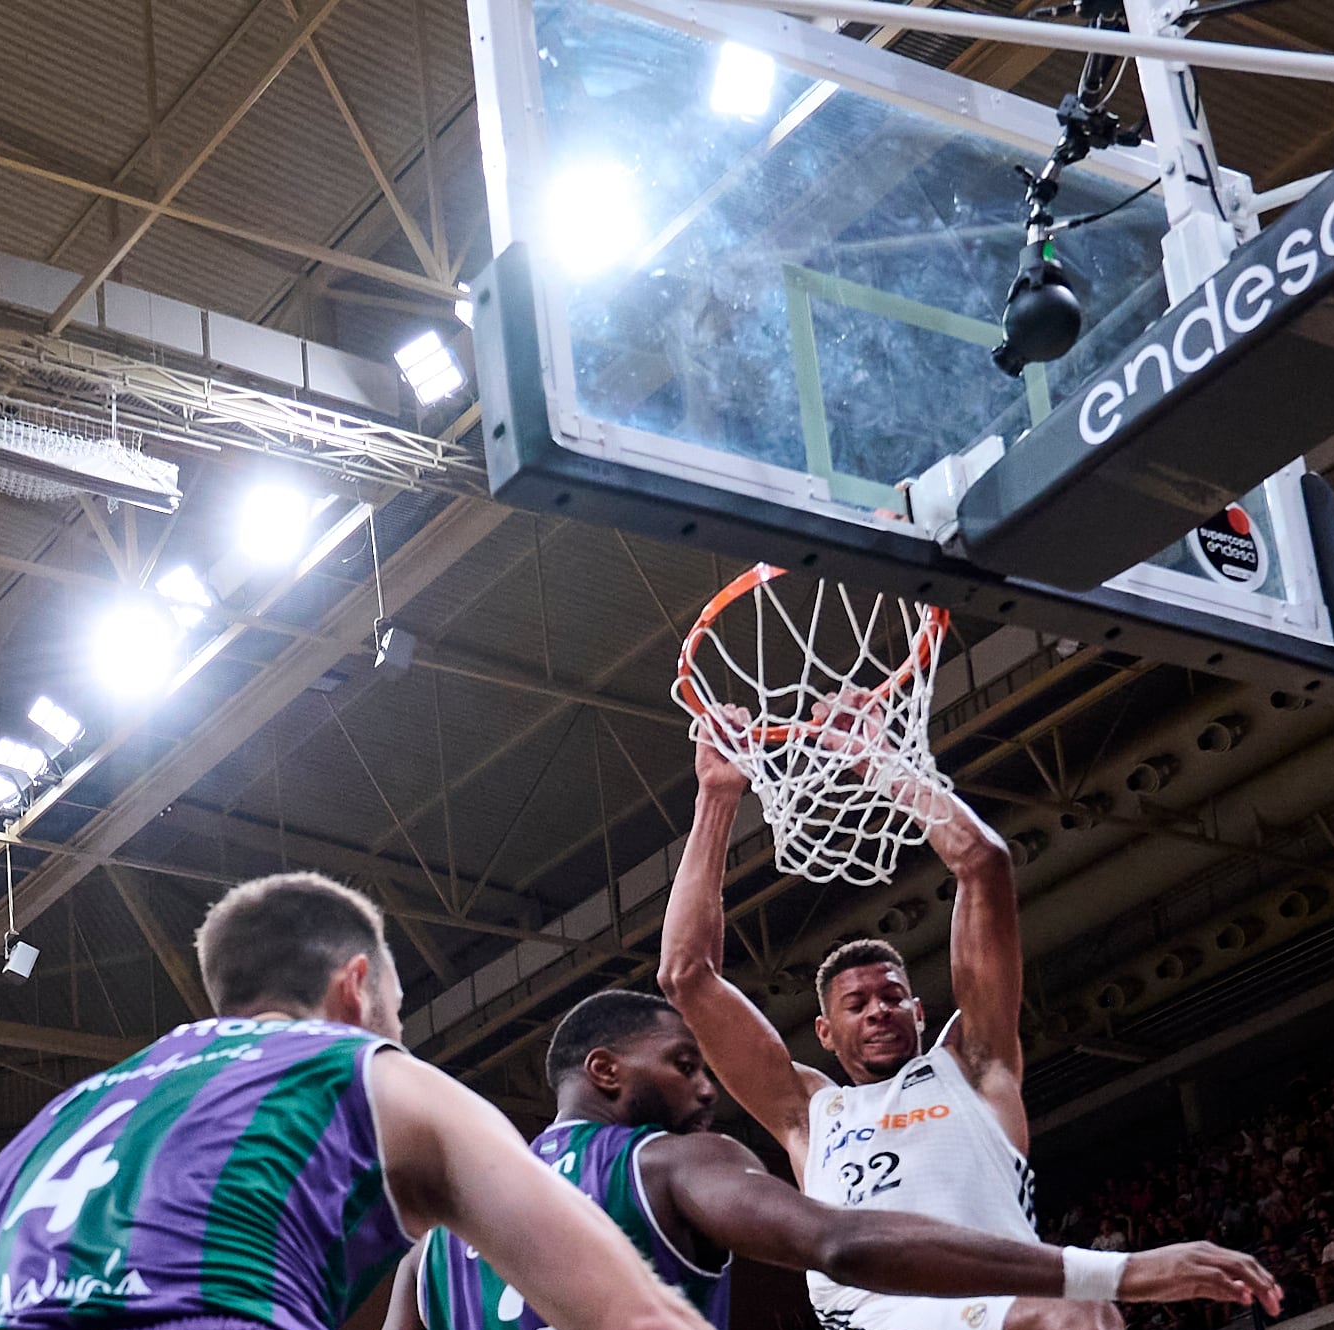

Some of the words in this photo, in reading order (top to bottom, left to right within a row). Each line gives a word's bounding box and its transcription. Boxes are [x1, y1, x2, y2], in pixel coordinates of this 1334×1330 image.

[1206, 541, 1257, 564] endesa
[3, 1097, 140, 1234] 4
[838, 1151, 902, 1207] 22
